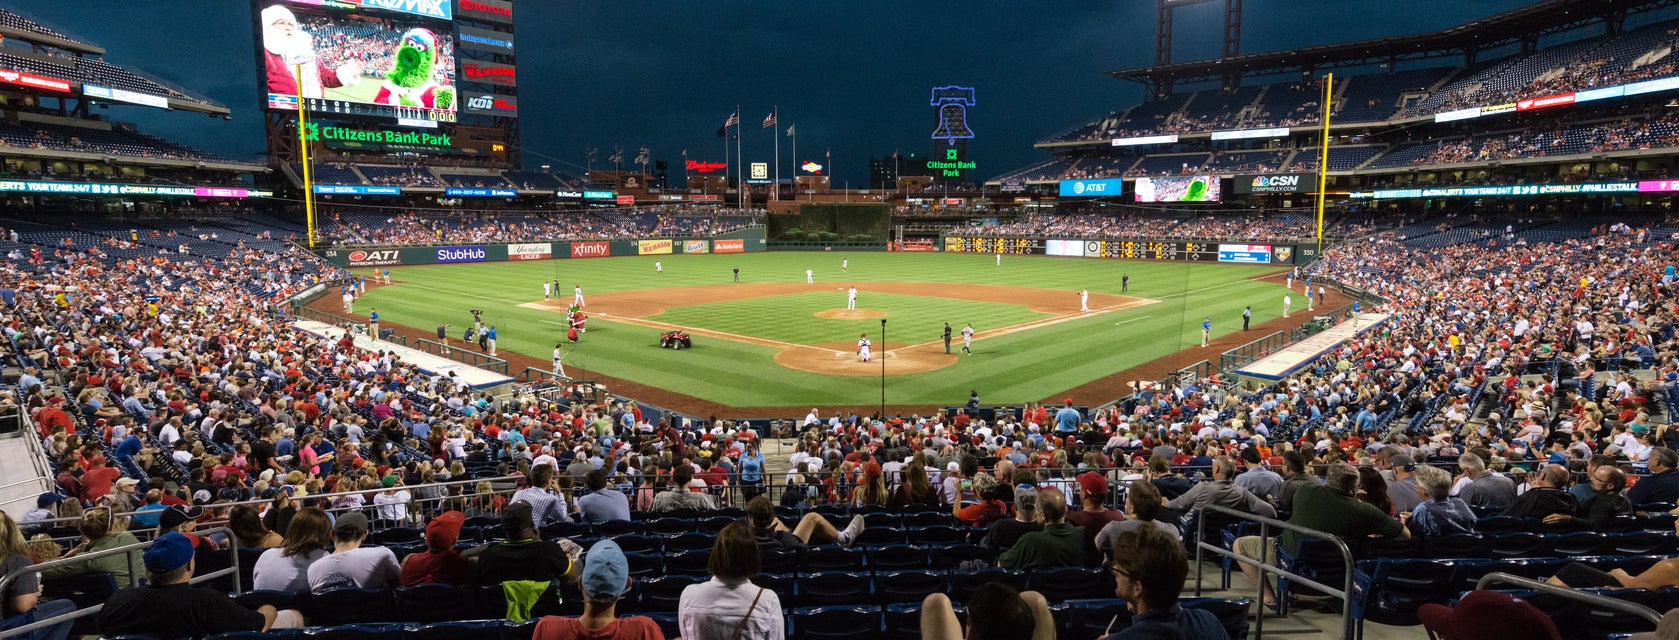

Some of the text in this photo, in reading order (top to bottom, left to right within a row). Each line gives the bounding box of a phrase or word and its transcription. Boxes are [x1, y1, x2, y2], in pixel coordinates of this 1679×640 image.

[470, 2, 511, 16] TOYOTA
[430, 111, 437, 121] 0
[323, 127, 451, 146] Citizens Bank Park
[686, 160, 727, 170] Budweiser
[926, 161, 977, 169] Citizens Bank
[943, 169, 960, 177] Park
[1269, 175, 1299, 186] CSN
[27, 183, 49, 191] YOUR
[73, 184, 91, 193] 24/7
[1086, 183, 1107, 192] AT&T
[1464, 187, 1480, 195] YOUR
[1498, 186, 1511, 194] 24/7
[1540, 184, 1581, 193] @CSNPHILLY
[1581, 182, 1637, 192] #PHILLIESTALK
[574, 243, 607, 256] xfinity
[687, 242, 704, 252] Gulf
[366, 250, 399, 261] ATI
[438, 248, 486, 260] StubHub
